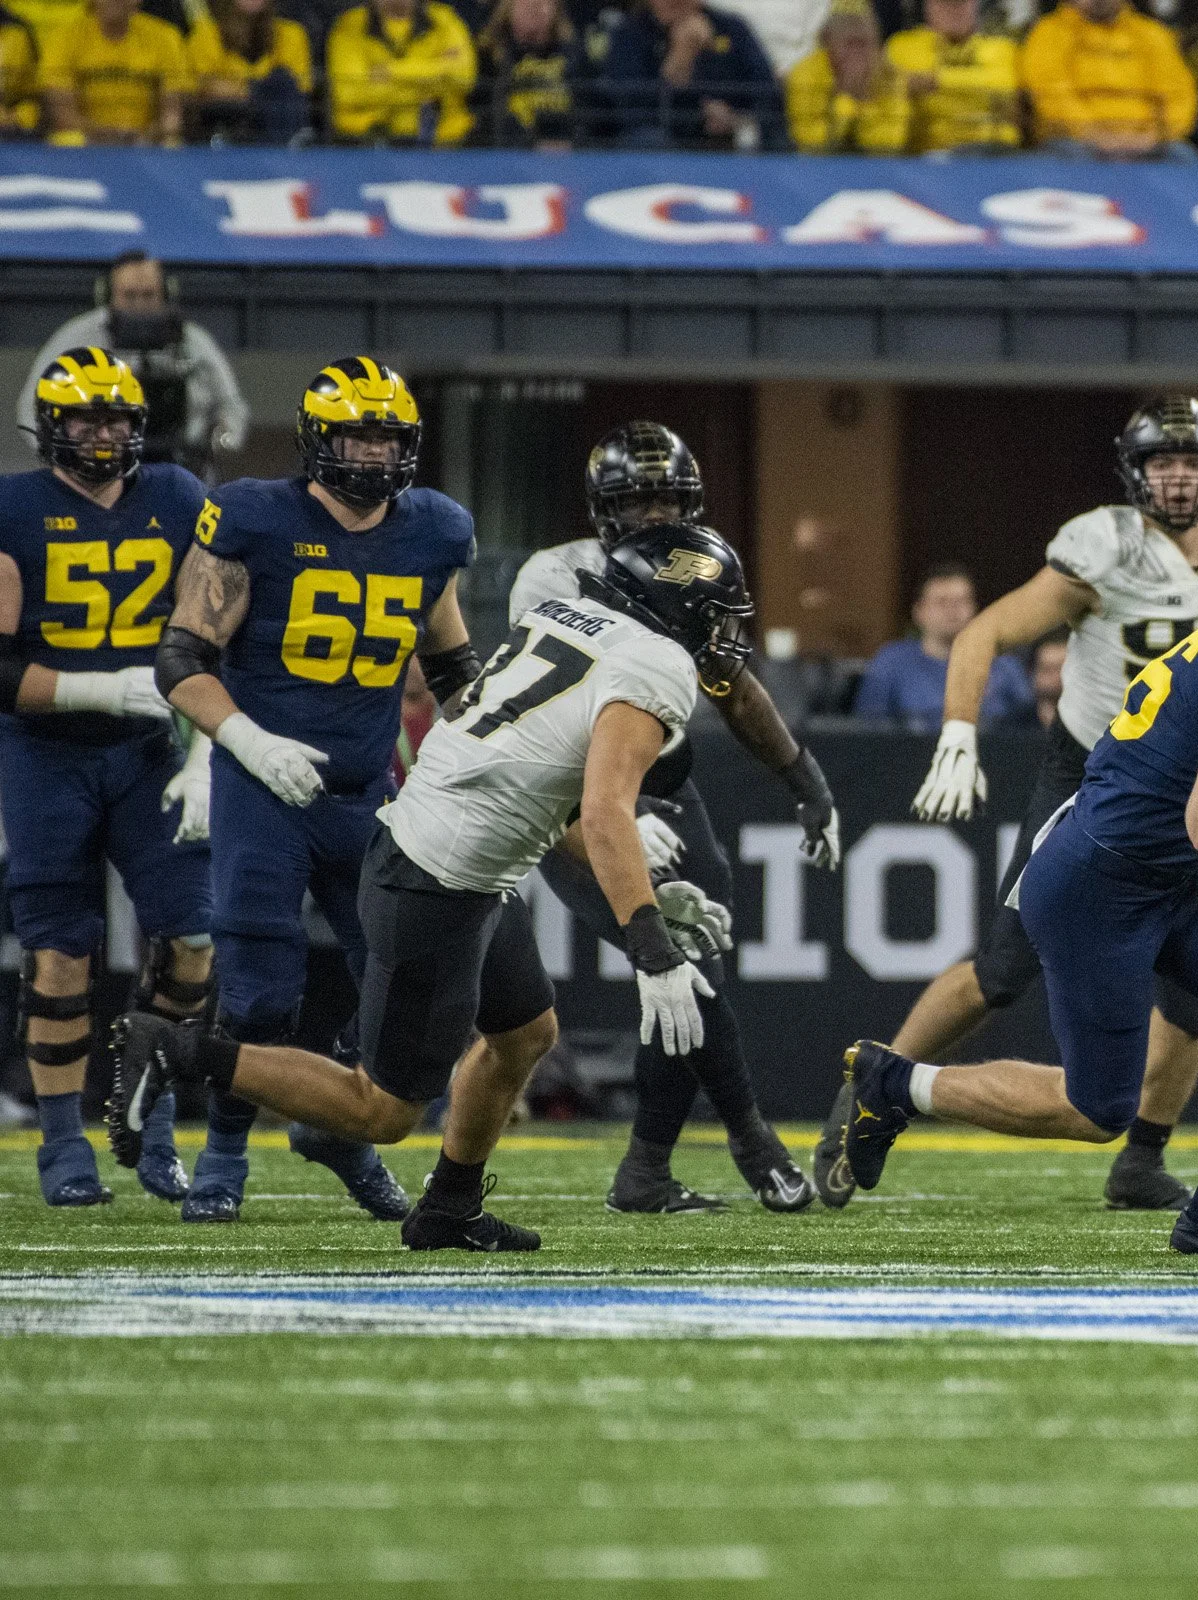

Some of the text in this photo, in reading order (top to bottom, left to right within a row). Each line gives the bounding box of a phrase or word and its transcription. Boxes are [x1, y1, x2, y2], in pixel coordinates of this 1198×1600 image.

[203, 177, 1147, 248] LUCAS
[40, 537, 174, 650] 52
[653, 548, 723, 586] P
[281, 568, 424, 687] 65
